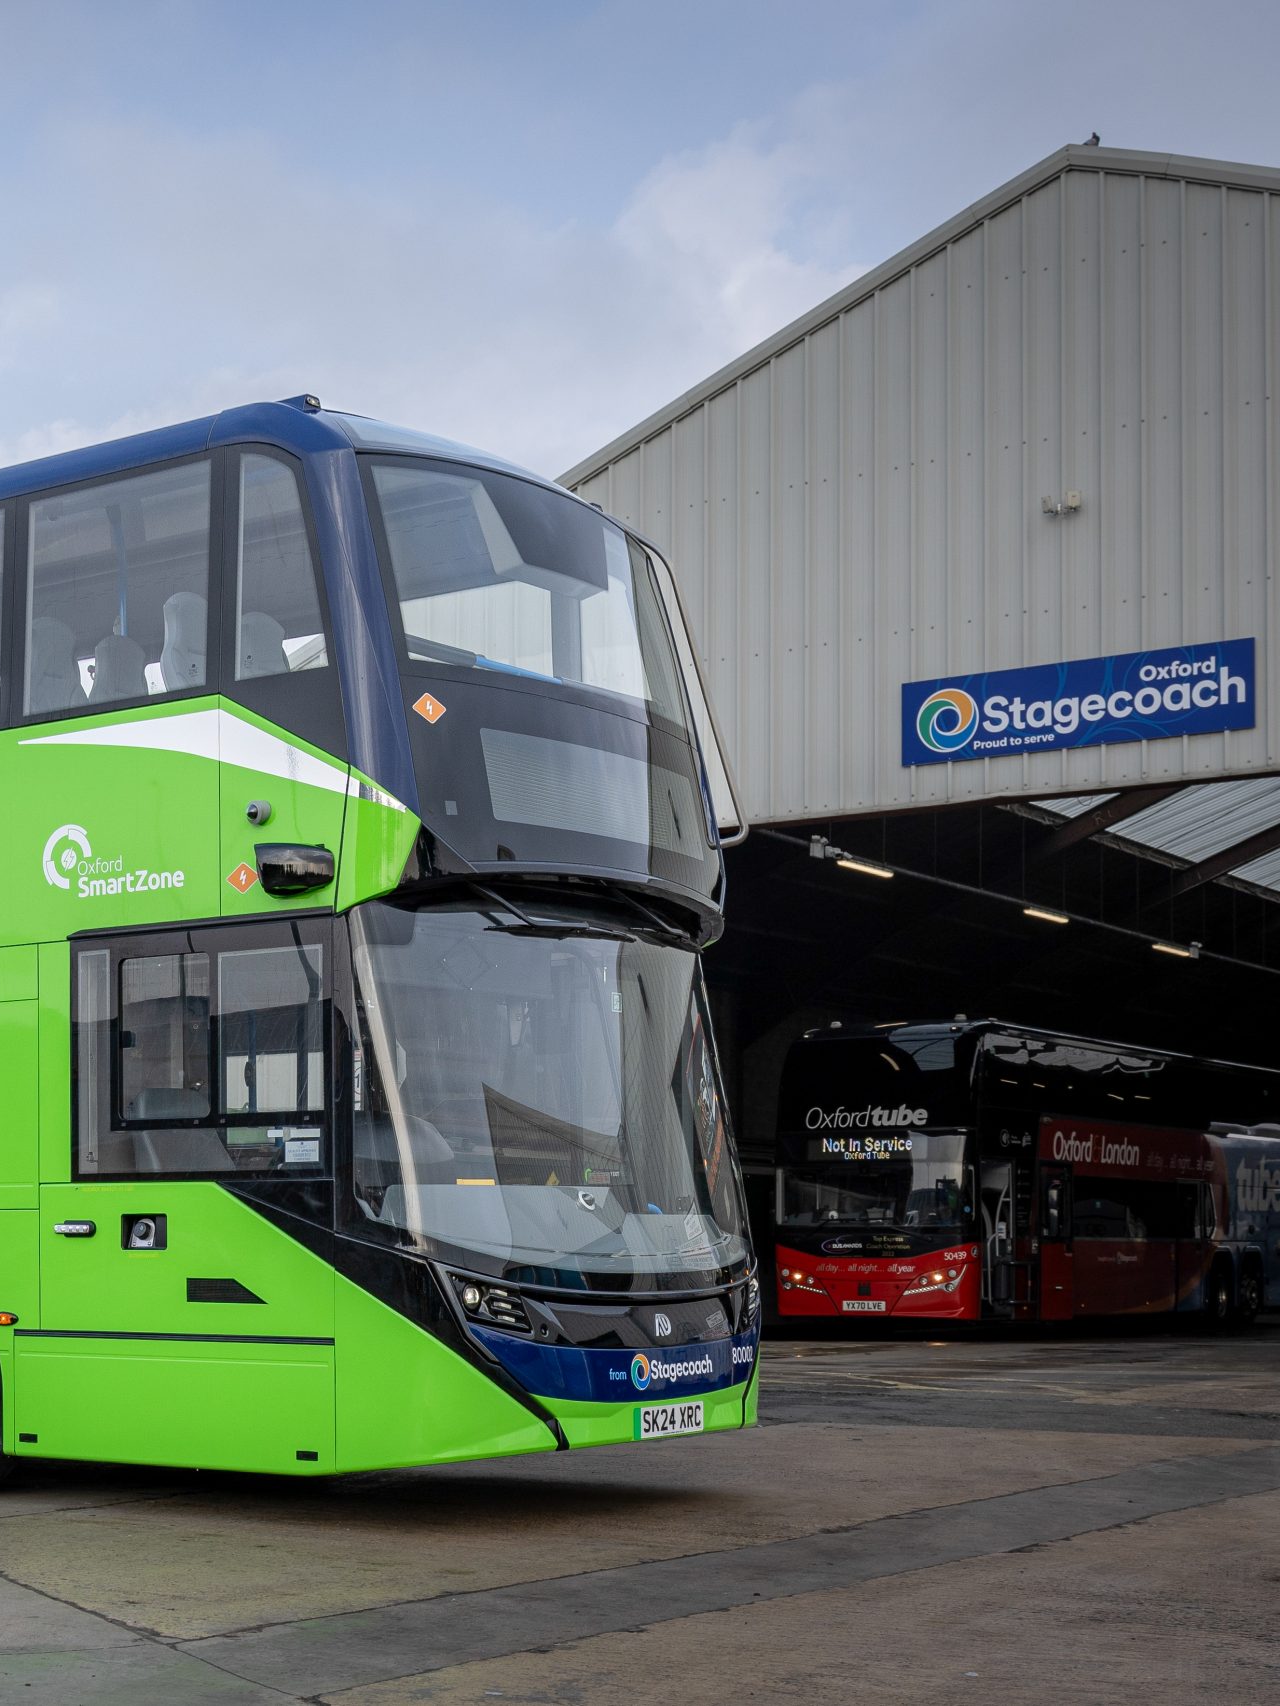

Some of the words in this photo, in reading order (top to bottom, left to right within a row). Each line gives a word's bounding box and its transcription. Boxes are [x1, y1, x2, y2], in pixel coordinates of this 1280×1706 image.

[1139, 656, 1217, 682] Oxford
[981, 666, 1246, 734] Stagecoach
[973, 737, 1008, 750] Proud
[1009, 735, 1022, 745] to
[1024, 733, 1055, 744] serve
[77, 855, 123, 876] Oxford
[78, 869, 185, 898] SmartZone
[822, 1137, 846, 1152] Not
[848, 1137, 861, 1152] In
[864, 1136, 913, 1151] Service
[1053, 1130, 1093, 1163] Oxford
[1100, 1136, 1140, 1166] London
[844, 1151, 871, 1160] Oxford
[872, 1151, 890, 1159] Tube
[944, 1251, 967, 1261] 50439
[848, 1264, 857, 1272] all
[887, 1264, 897, 1272] all
[896, 1265, 916, 1274] year
[845, 1302, 866, 1310] YX70
[867, 1302, 883, 1310] LVE
[732, 1345, 753, 1364] 80002
[609, 1368, 627, 1381] from
[650, 1354, 713, 1383] Stagecoach
[643, 1407, 677, 1433] SK24
[679, 1404, 701, 1429] XRC
